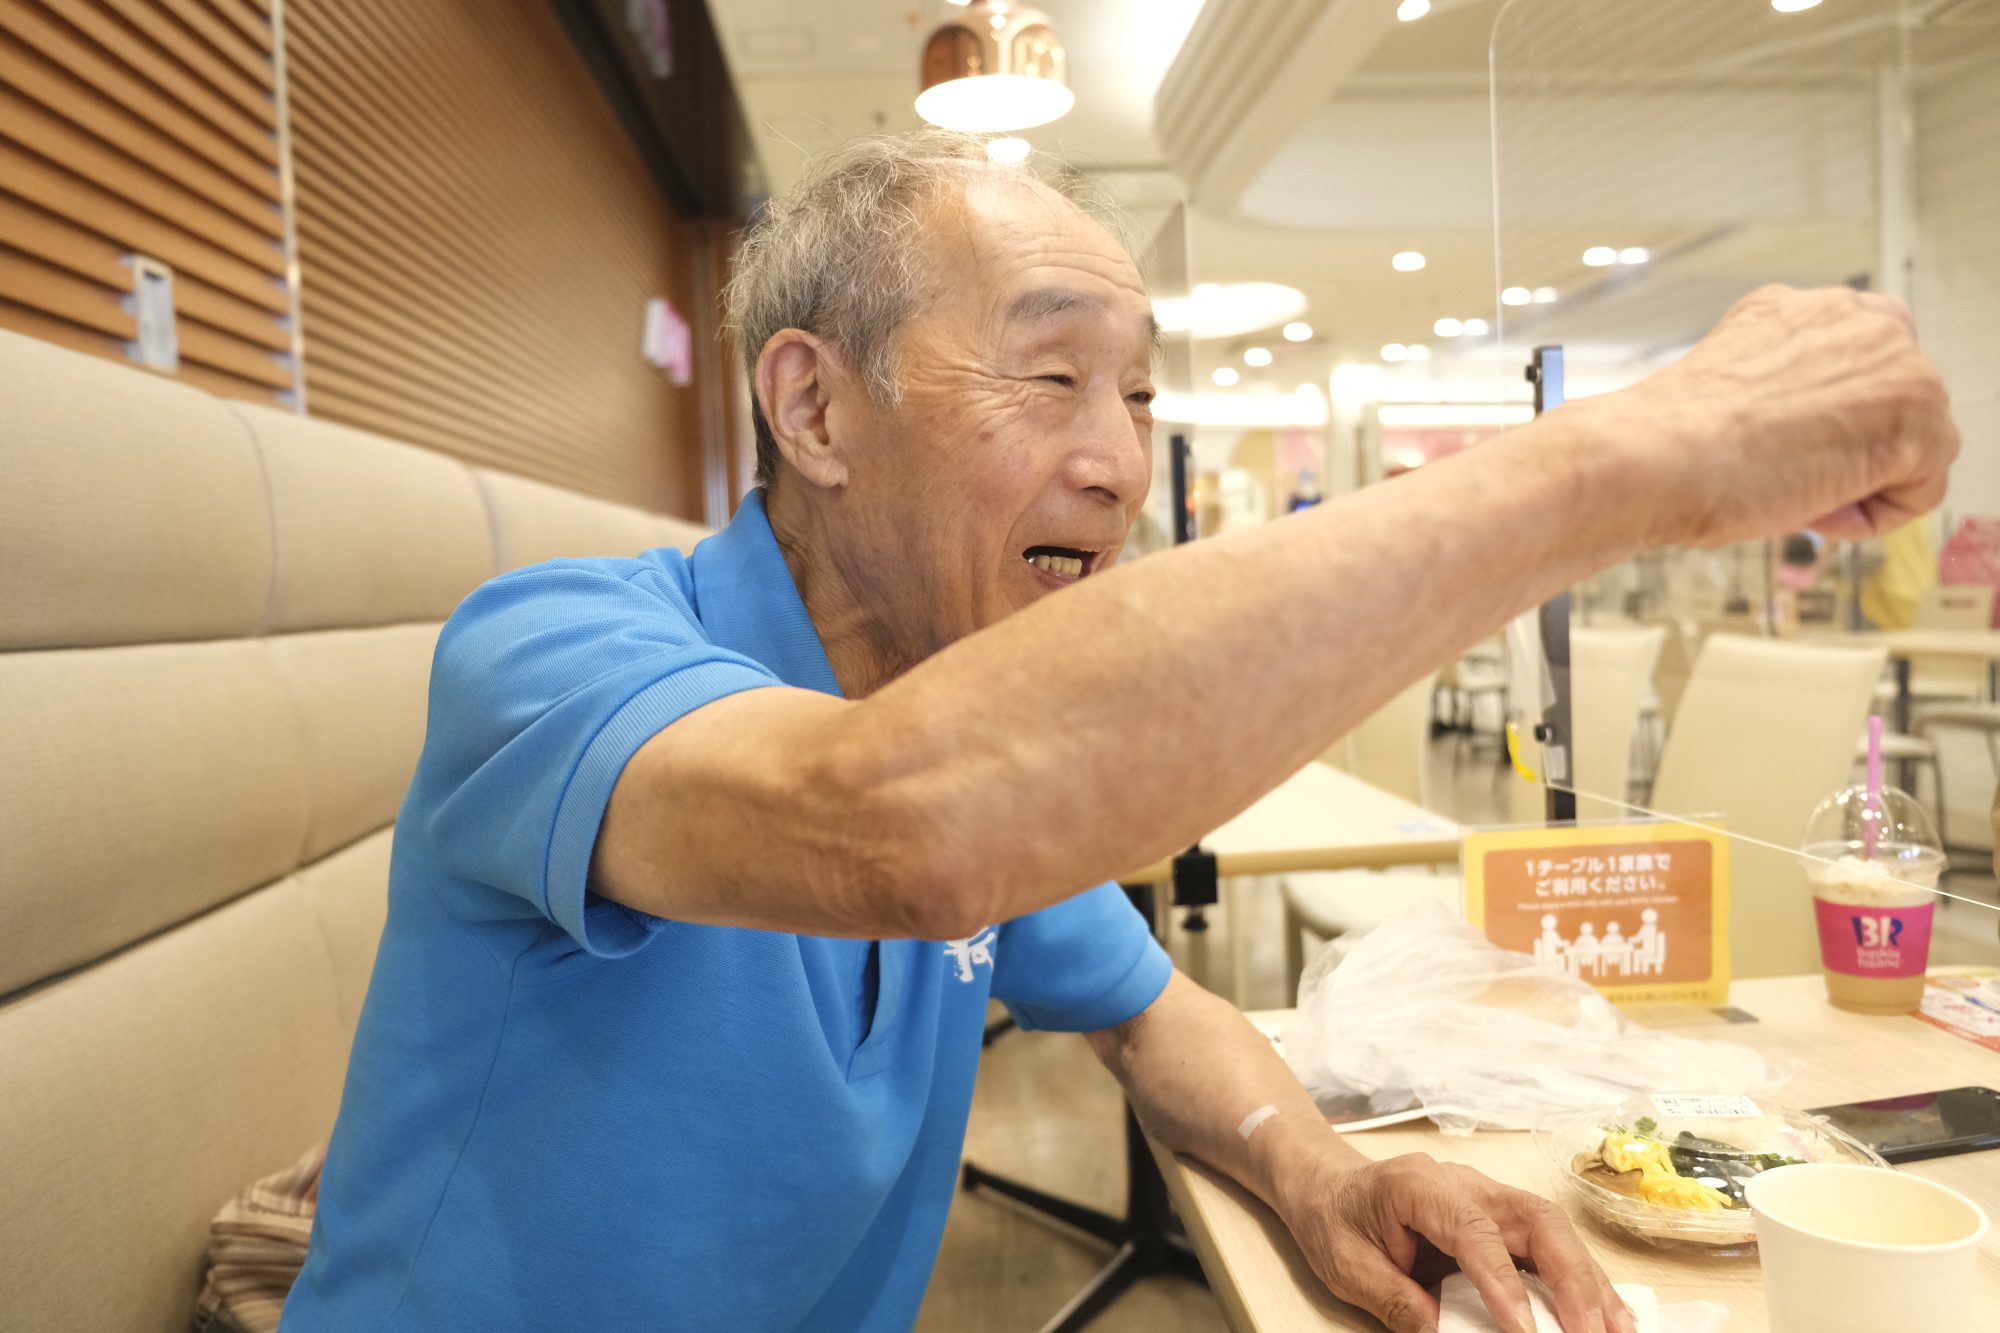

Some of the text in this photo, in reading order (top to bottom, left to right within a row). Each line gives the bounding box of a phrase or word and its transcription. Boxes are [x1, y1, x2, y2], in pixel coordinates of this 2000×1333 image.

[1536, 876, 1666, 896] ご利用ください。
[1851, 916, 1904, 947] BR
